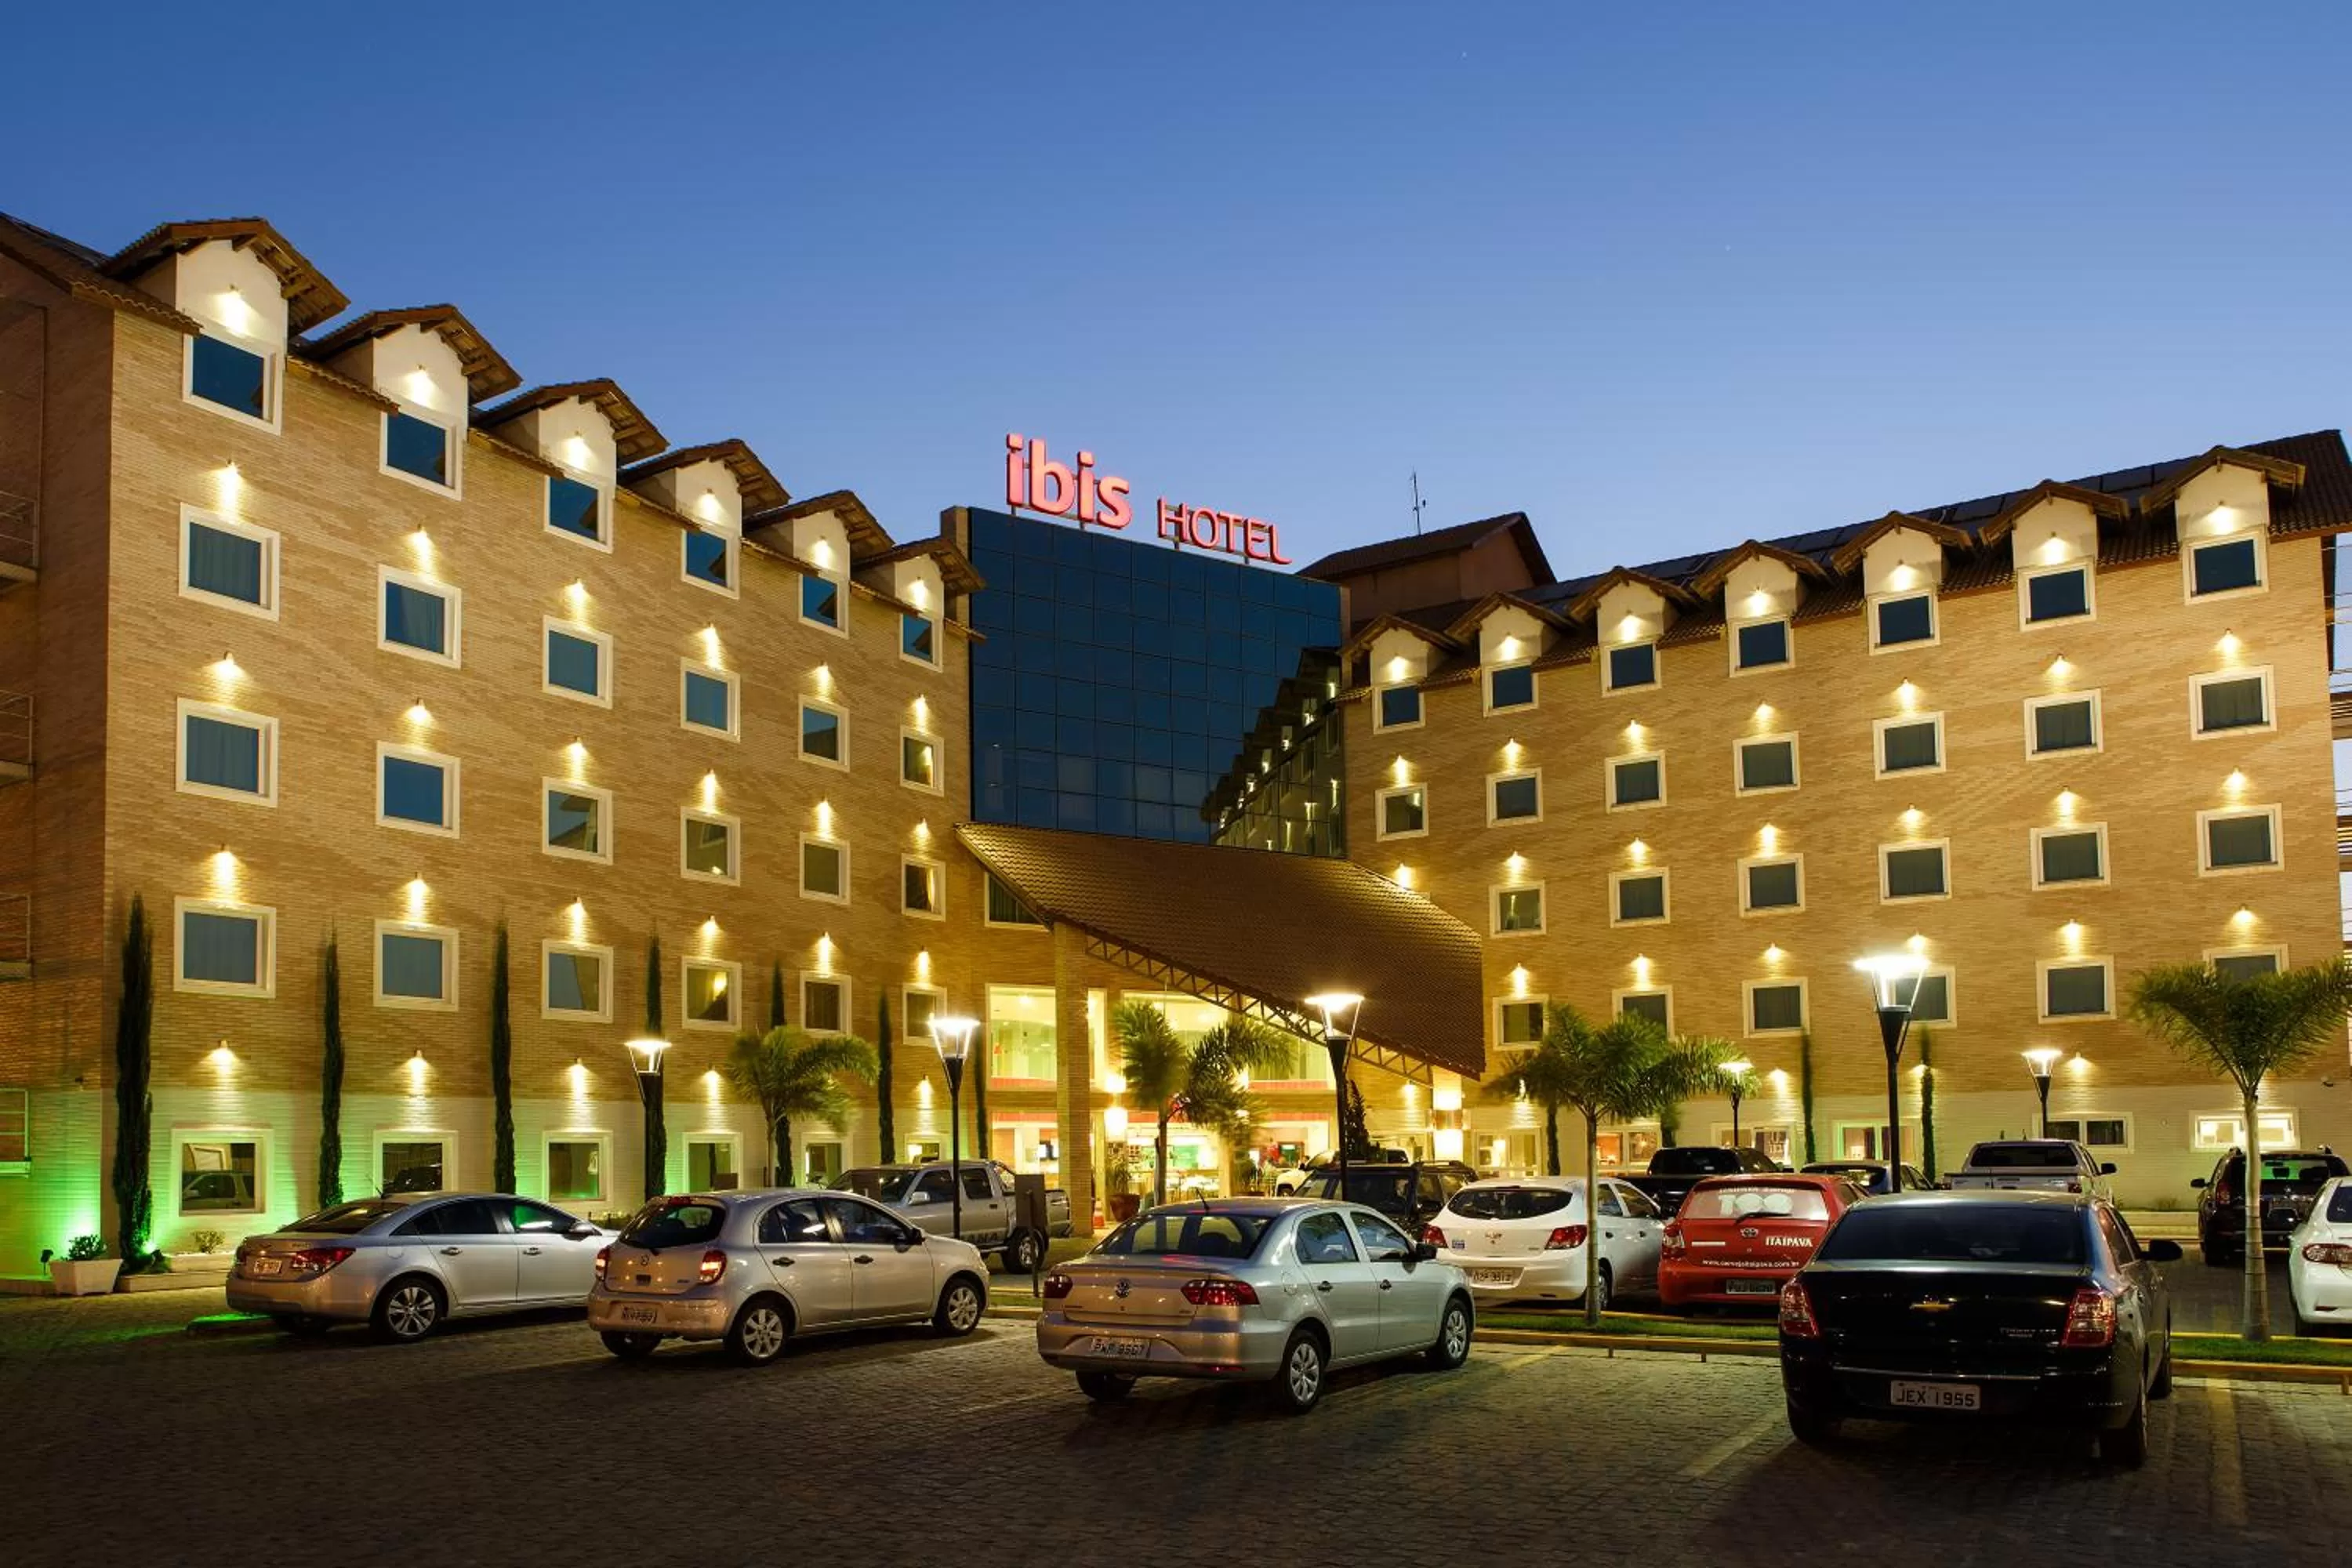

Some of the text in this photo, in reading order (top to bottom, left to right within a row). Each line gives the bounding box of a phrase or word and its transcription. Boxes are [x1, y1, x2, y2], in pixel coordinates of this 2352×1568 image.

[1007, 434, 1292, 564] ibis HOTEL
[1765, 1236, 1813, 1247] ITAIPAVA
